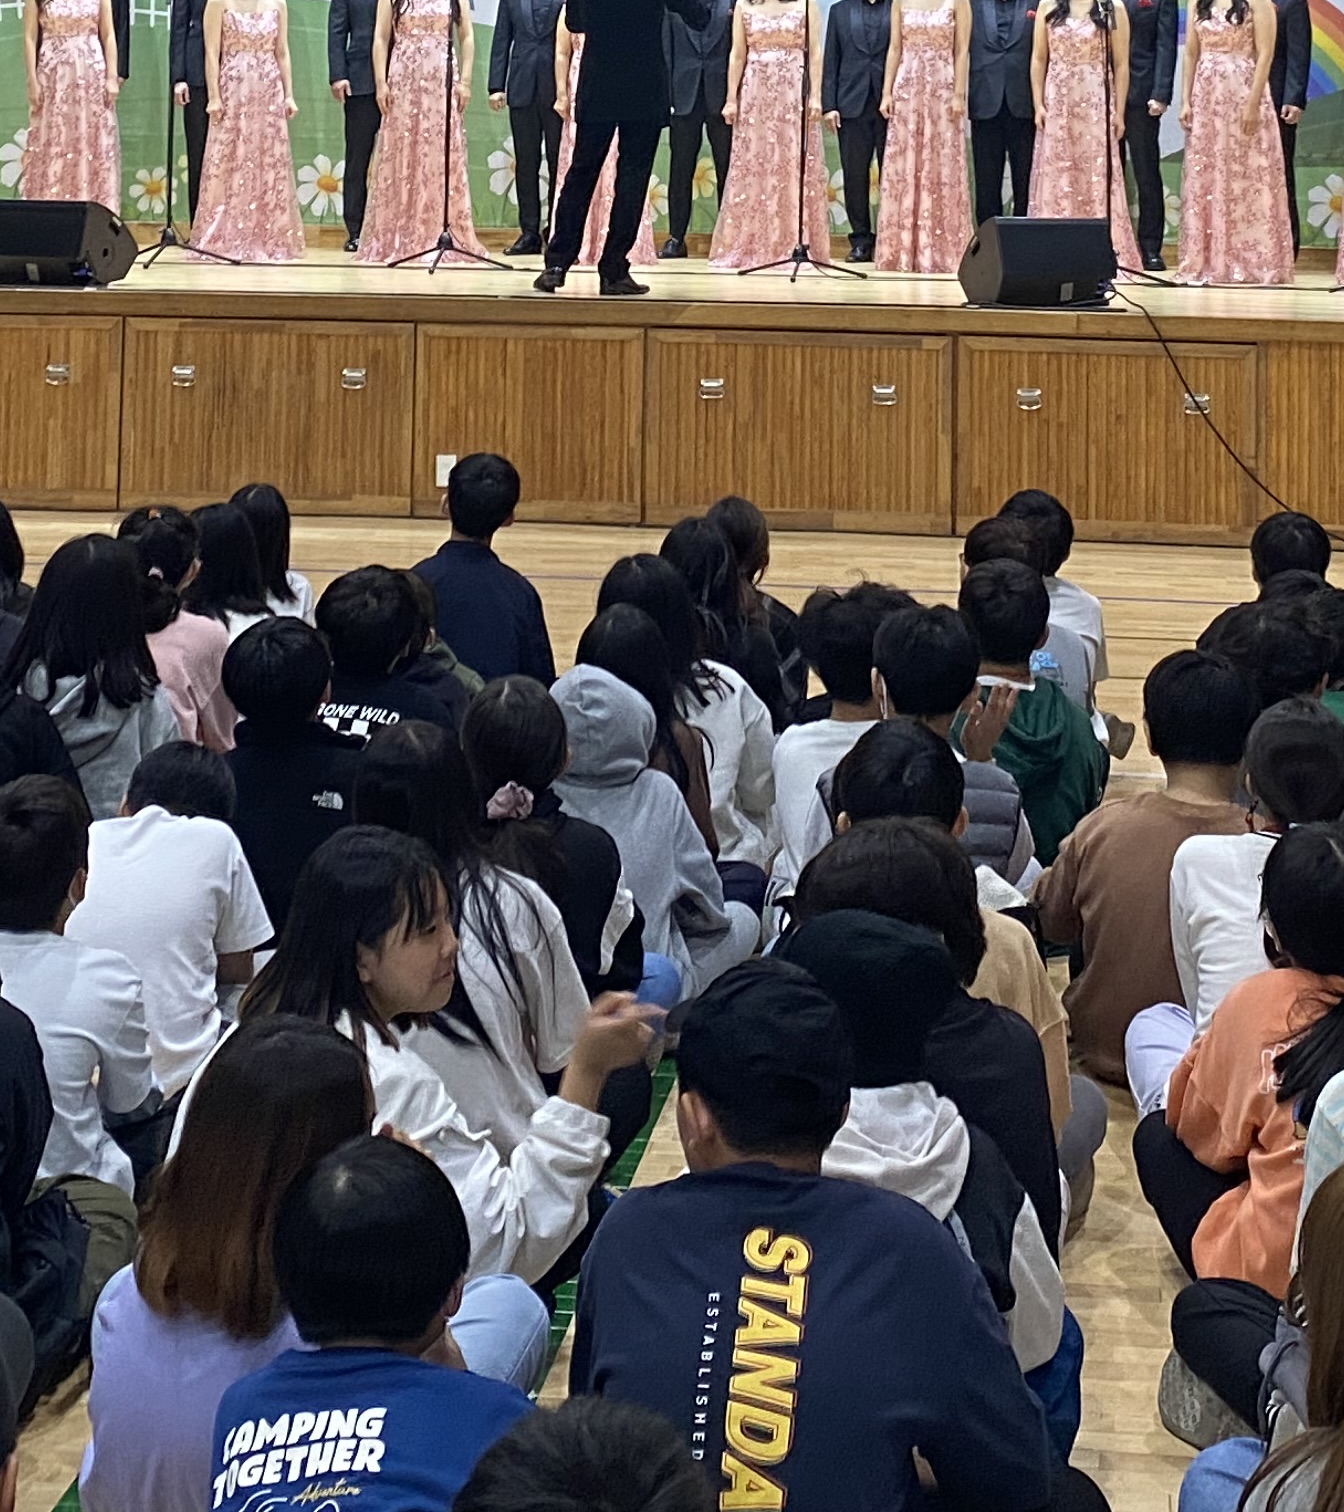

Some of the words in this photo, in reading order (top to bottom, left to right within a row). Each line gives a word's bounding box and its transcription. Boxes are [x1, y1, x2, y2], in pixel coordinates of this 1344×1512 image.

[359, 705, 400, 725] WILD
[691, 1292, 721, 1461] ESTABLISHED
[213, 1437, 386, 1510] TOGETHER
